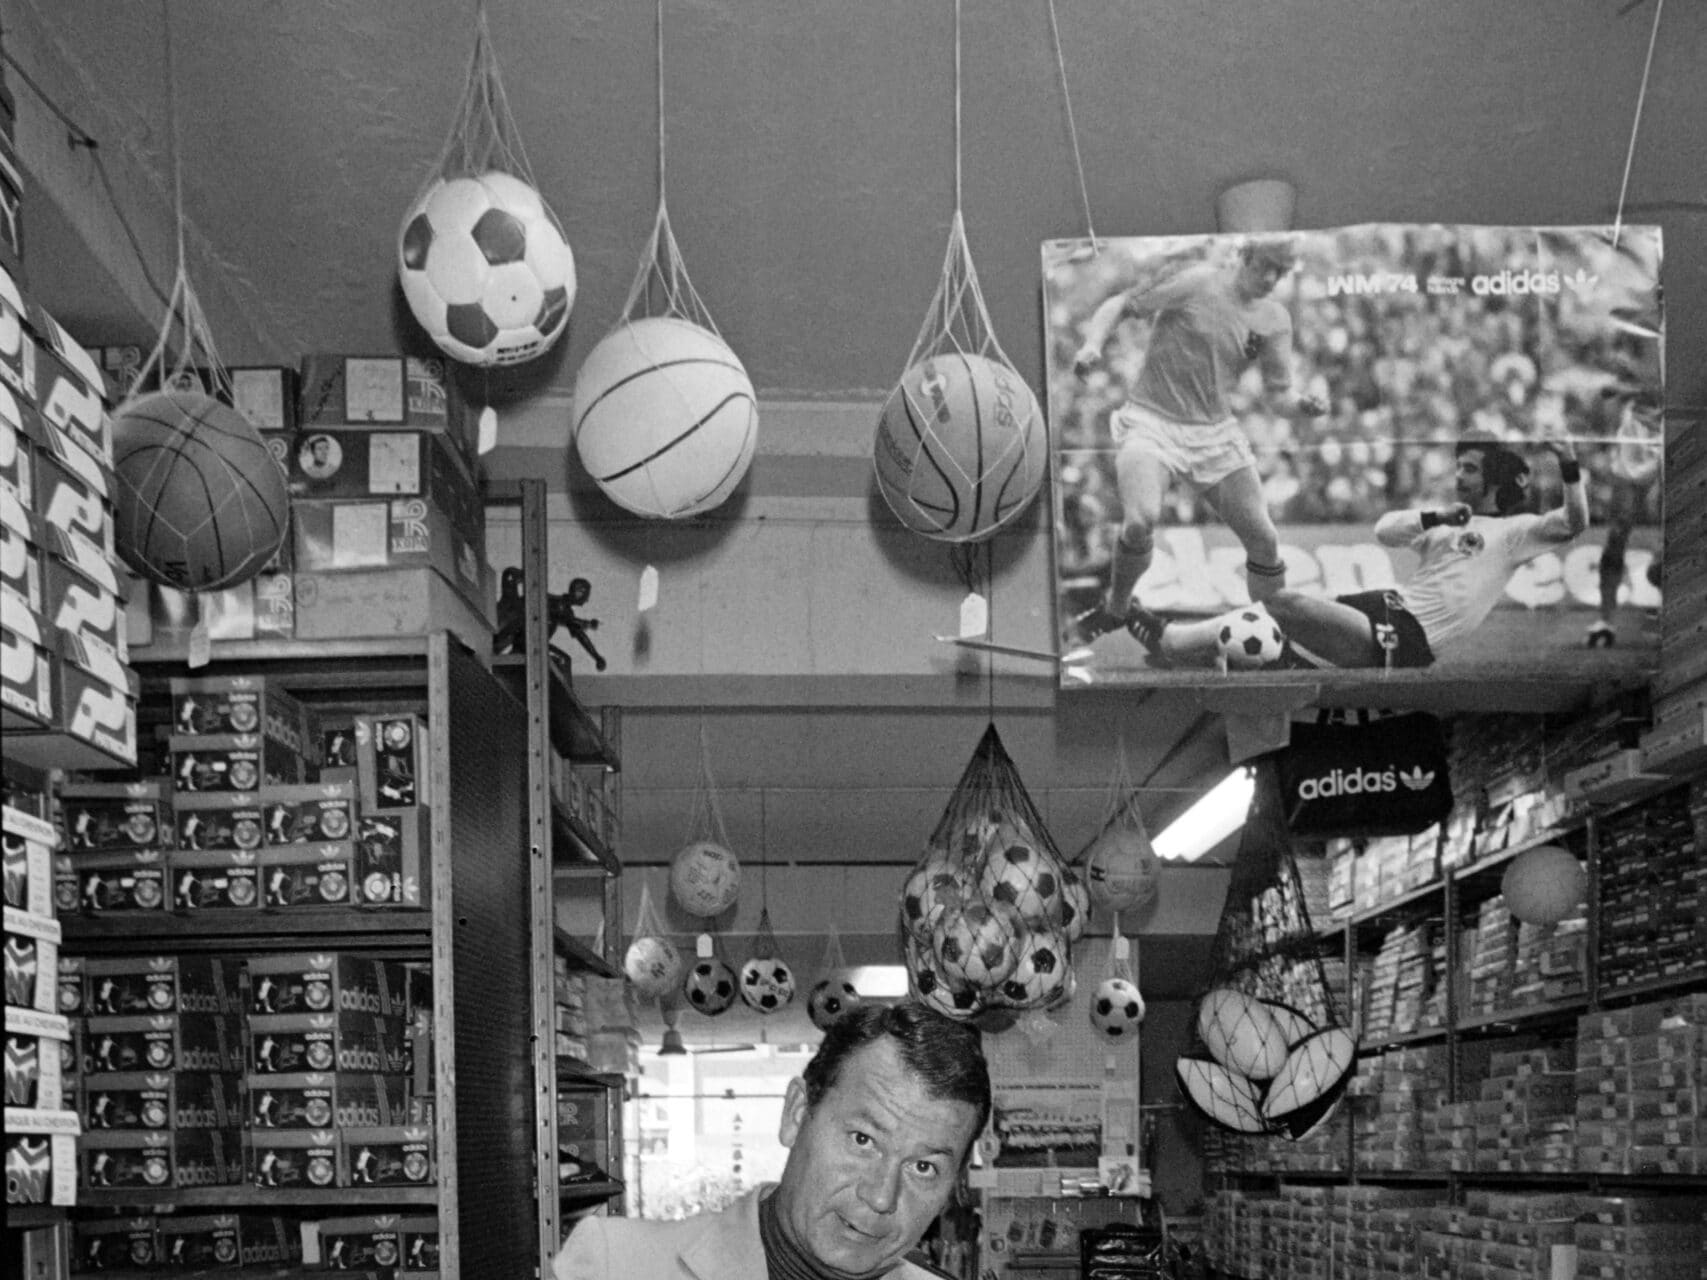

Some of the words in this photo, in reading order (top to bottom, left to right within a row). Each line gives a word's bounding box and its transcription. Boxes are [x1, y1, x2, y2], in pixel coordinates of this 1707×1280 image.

[1386, 273, 1418, 294] 74
[1471, 269, 1561, 296] adidas
[1298, 767, 1397, 800] adidas
